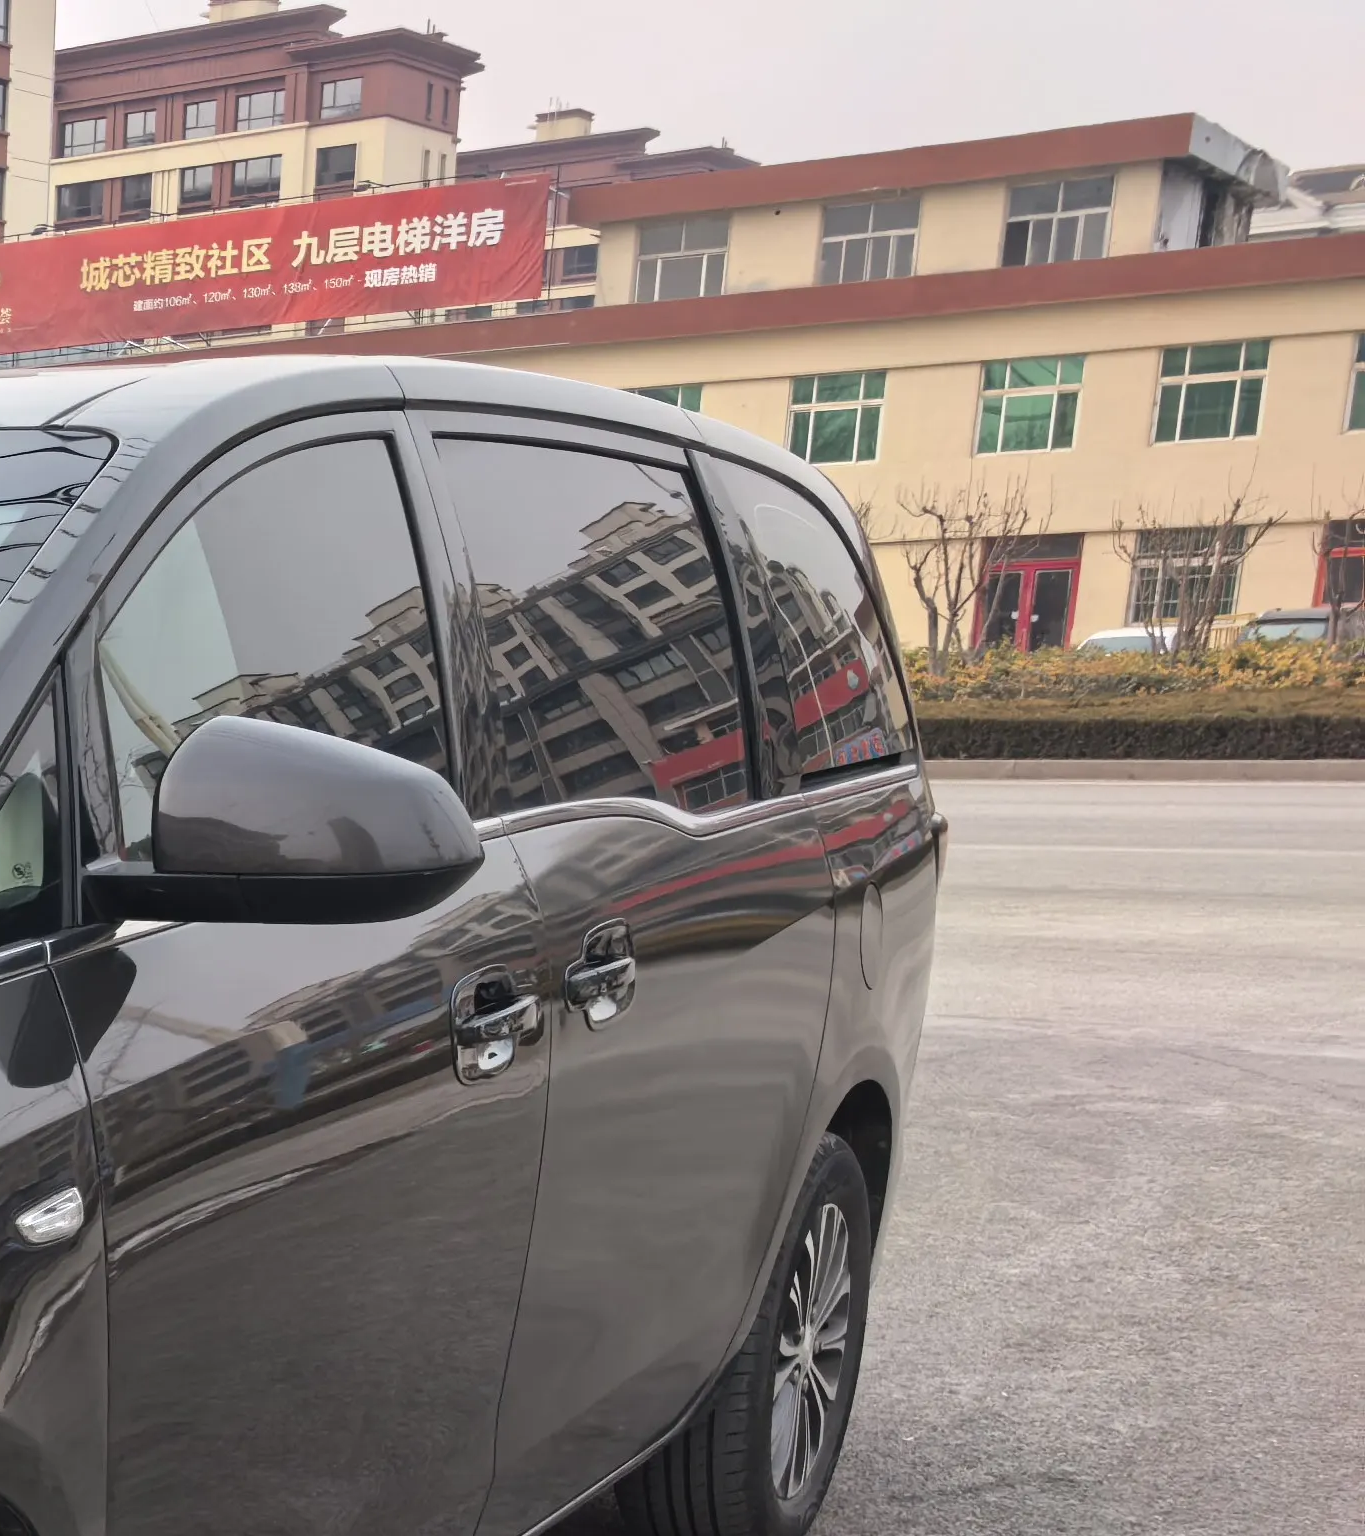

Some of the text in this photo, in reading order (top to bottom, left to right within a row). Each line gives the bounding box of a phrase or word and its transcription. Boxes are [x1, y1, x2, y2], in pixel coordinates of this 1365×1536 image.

[79, 208, 505, 292] 城芯精致社区 九层电梯洋房
[364, 263, 437, 288] 现房热销
